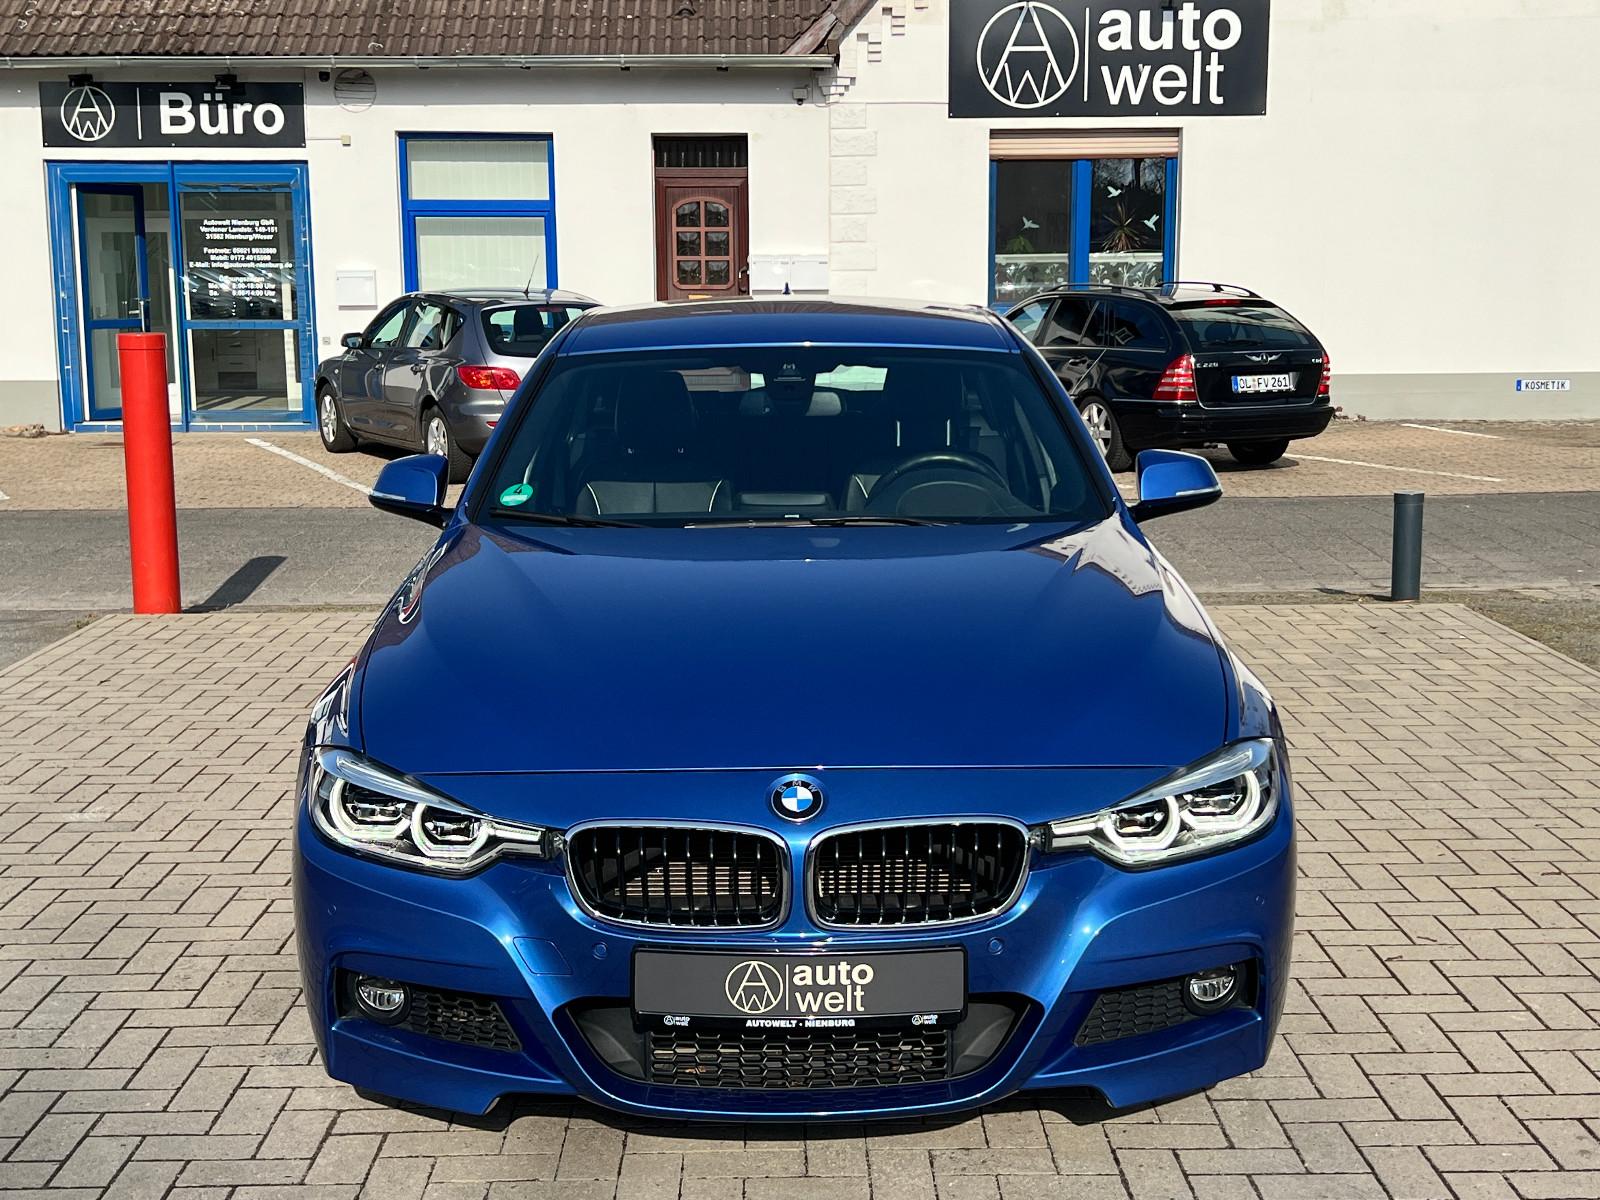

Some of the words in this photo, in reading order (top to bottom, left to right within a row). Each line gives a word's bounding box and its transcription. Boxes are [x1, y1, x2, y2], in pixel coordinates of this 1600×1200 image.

[1097, 2, 1242, 51] auto
[1100, 50, 1225, 106] welt
[159, 91, 285, 135] Büro
[231, 219, 259, 227] Nienburg
[225, 233, 274, 241] Nienburg/Weser
[1239, 378, 1251, 389] OL
[1257, 377, 1269, 388] FV
[1271, 376, 1288, 387] 261
[1525, 381, 1566, 390] KOSMETIK
[777, 780, 819, 793] BMW
[792, 961, 874, 986] auto
[795, 985, 865, 1012] welt
[745, 1019, 797, 1028] AUTOWELT
[804, 1019, 856, 1028] NIENBURG
